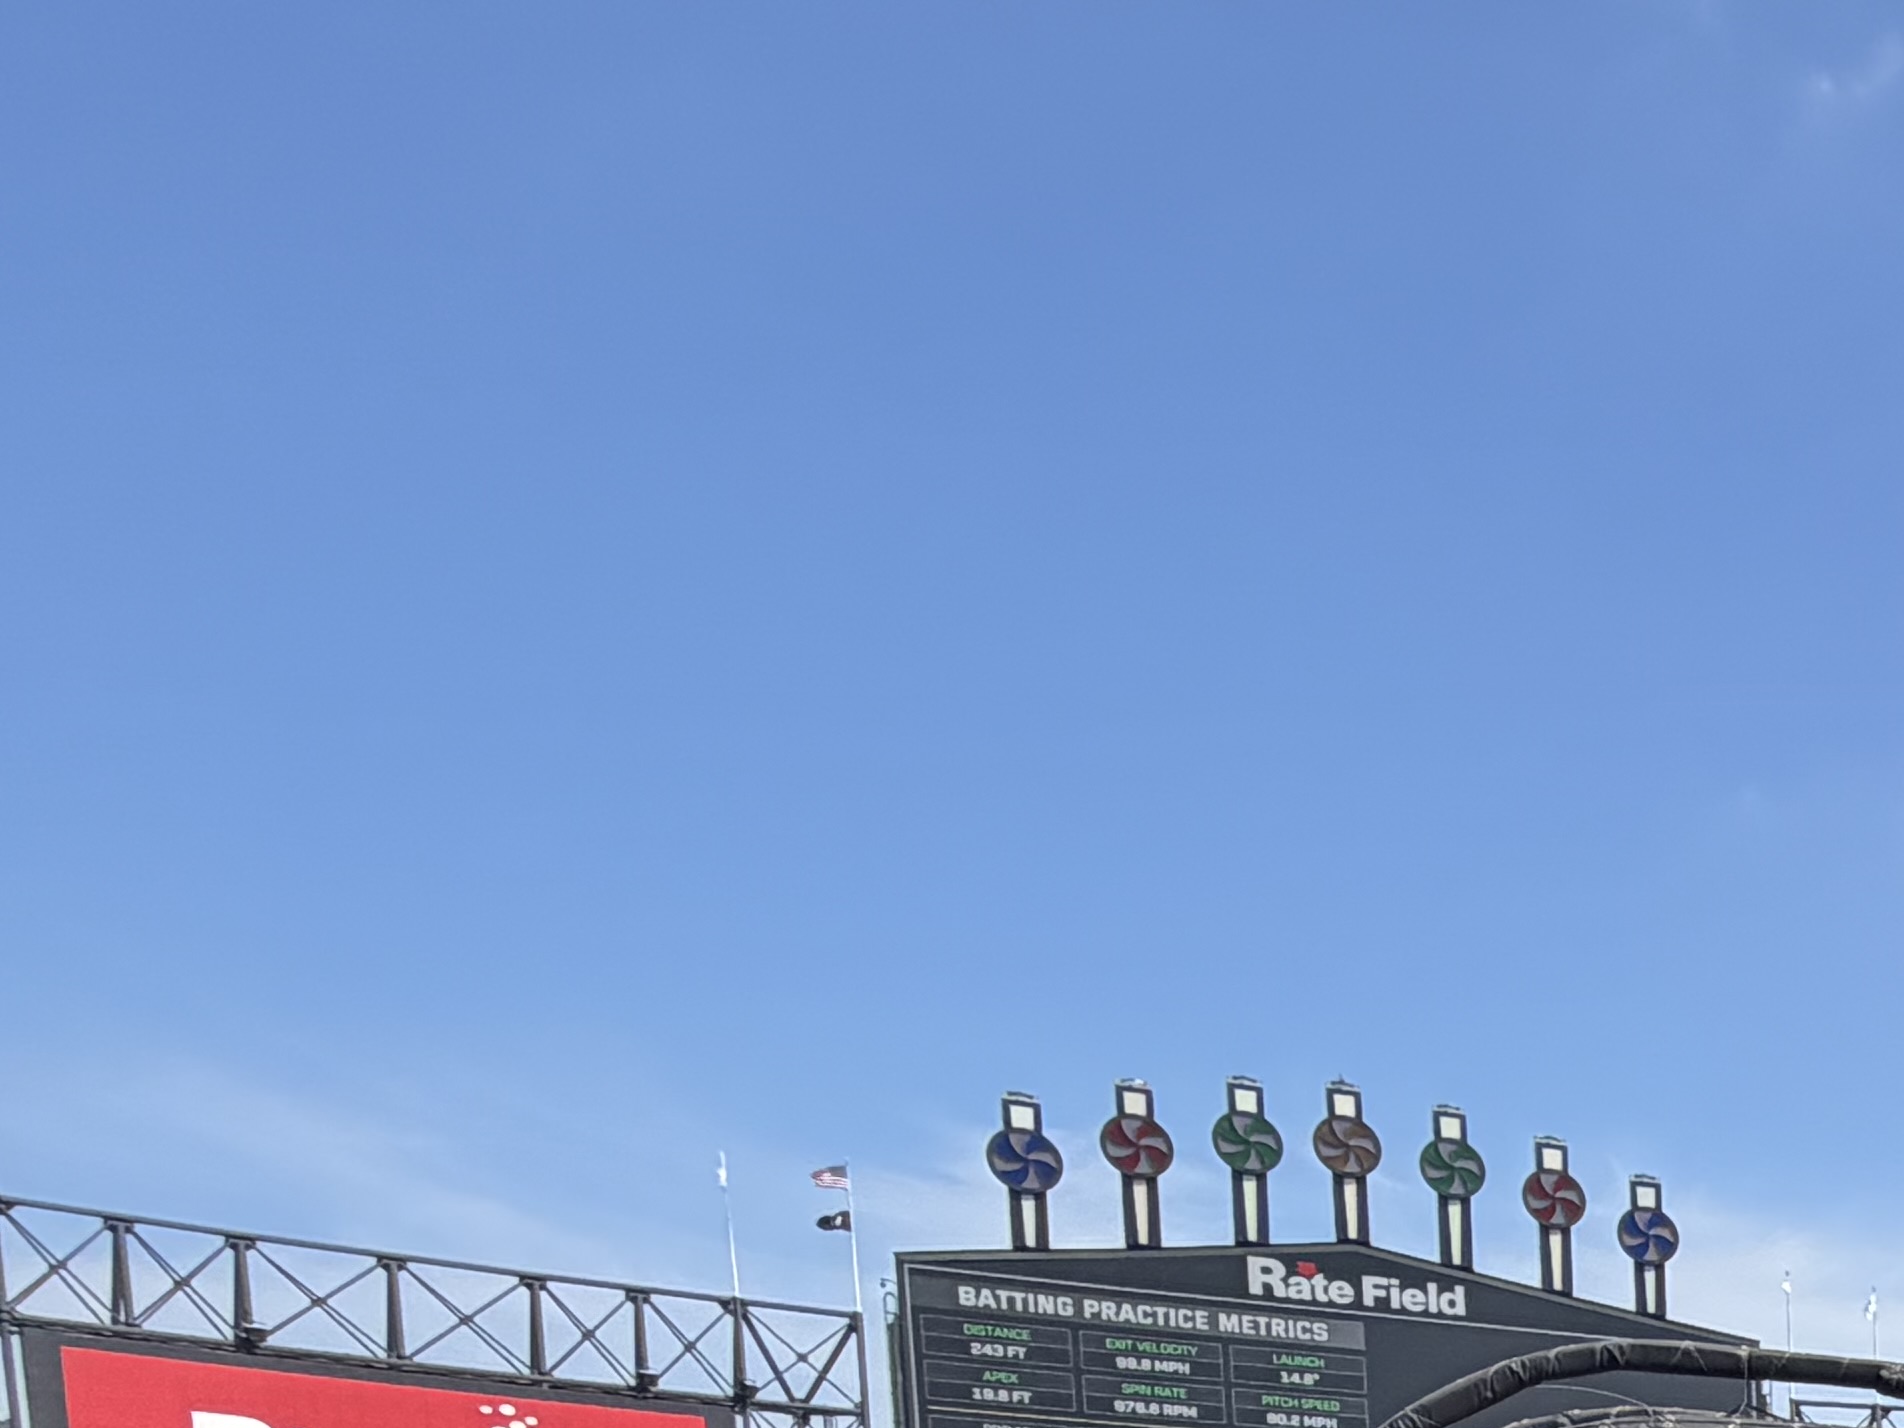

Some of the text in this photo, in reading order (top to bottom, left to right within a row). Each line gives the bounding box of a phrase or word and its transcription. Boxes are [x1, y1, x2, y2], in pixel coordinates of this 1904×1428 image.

[1246, 1255, 1467, 1317] Rate Field
[957, 1285, 1330, 1342] BATTING PRACTICE METRICS
[963, 1323, 1032, 1341] DISTANCE
[970, 1342, 1028, 1360] 243 FT
[1105, 1337, 1198, 1356] EXIT VELOCITY
[1154, 1360, 1191, 1375] MPH
[1272, 1353, 1325, 1369] LAUNCH
[982, 1370, 1019, 1384] APEX
[1012, 1391, 1032, 1404] FT
[1121, 1383, 1188, 1400] SPIN RATE
[1162, 1404, 1198, 1419] RPM
[1261, 1395, 1341, 1412] PITCH SPEED
